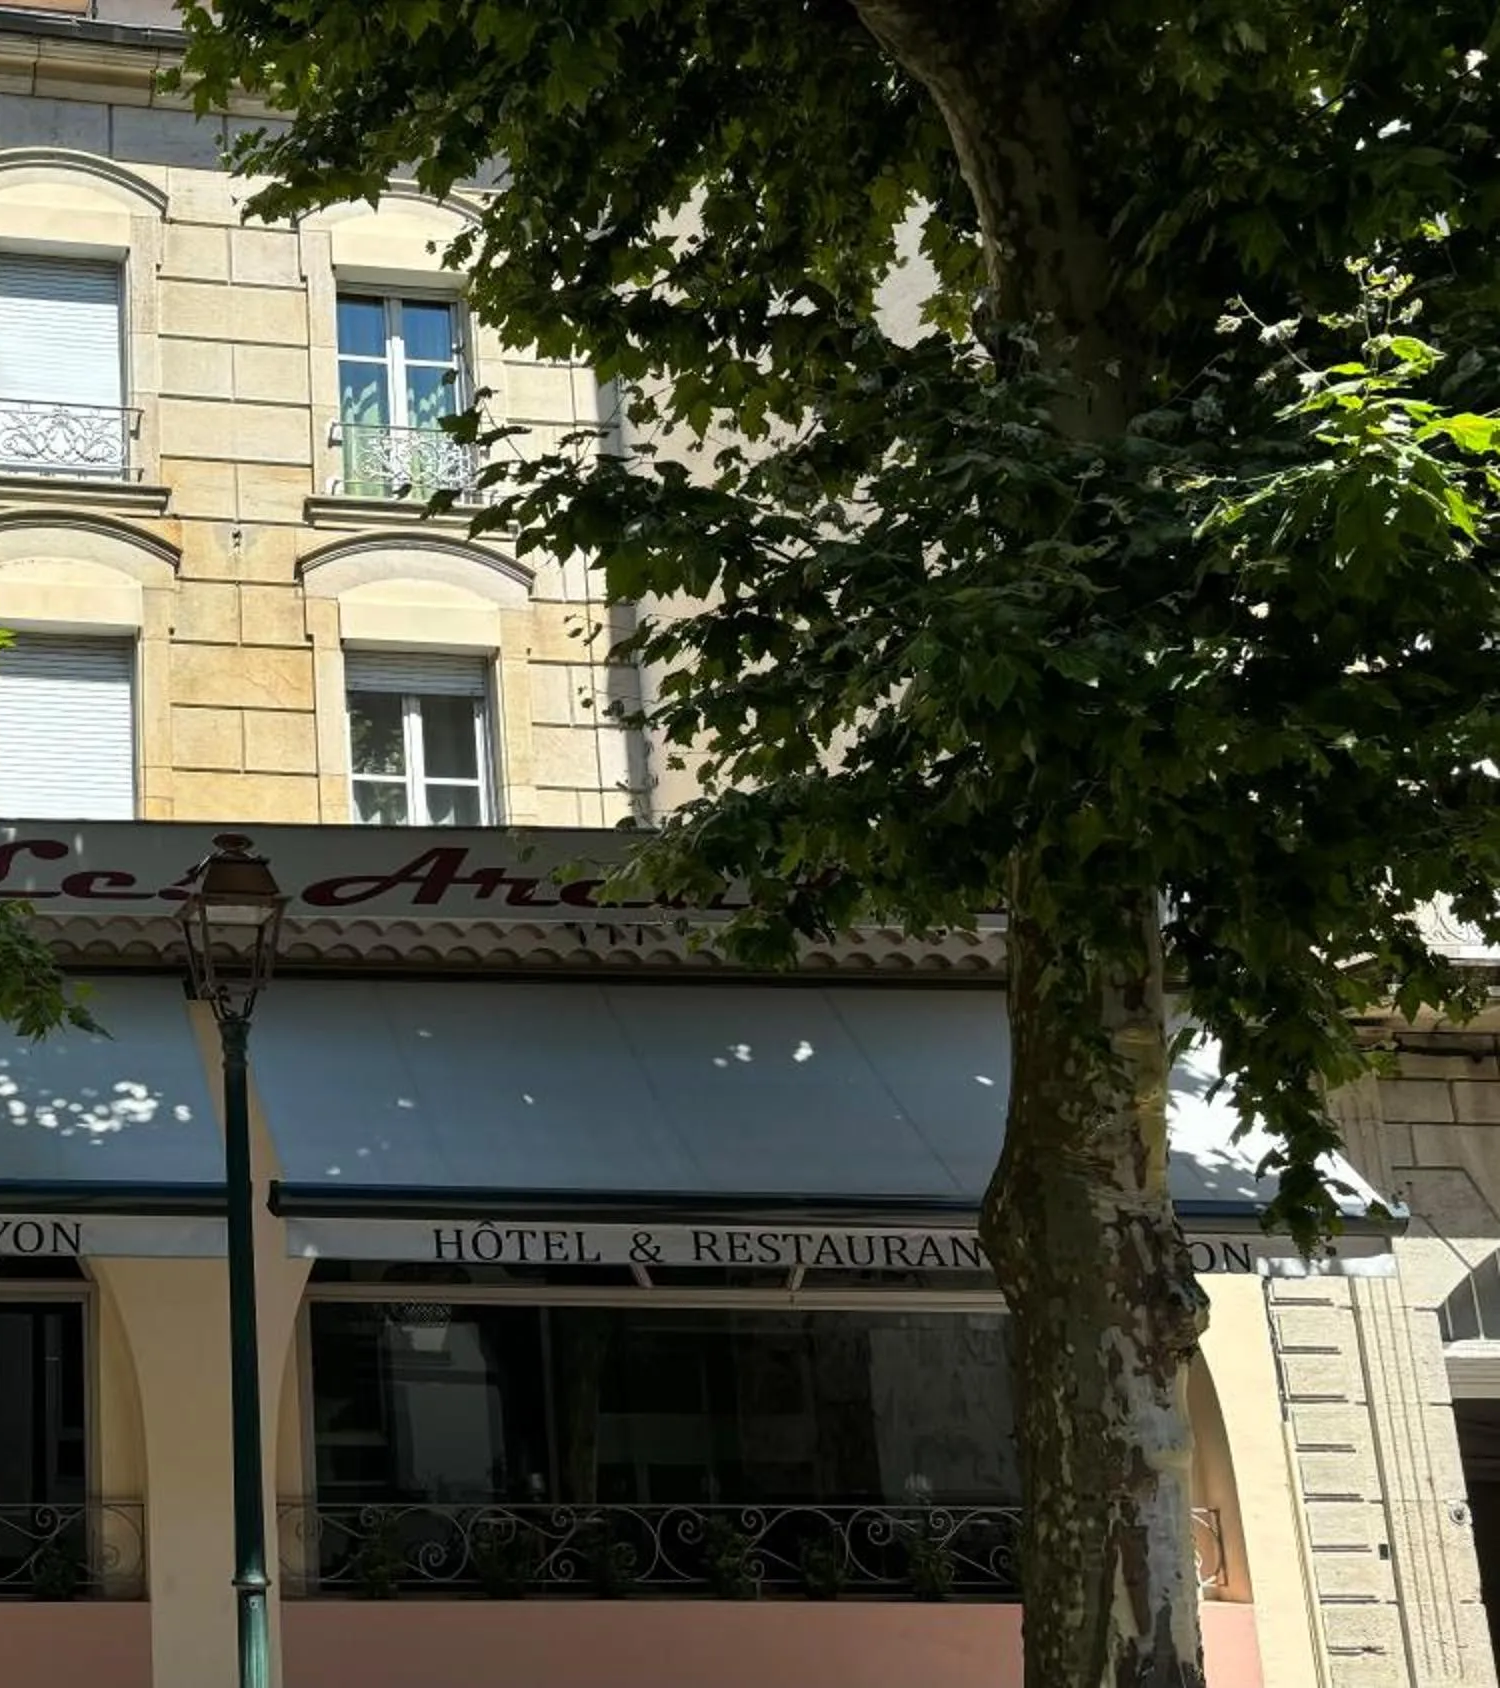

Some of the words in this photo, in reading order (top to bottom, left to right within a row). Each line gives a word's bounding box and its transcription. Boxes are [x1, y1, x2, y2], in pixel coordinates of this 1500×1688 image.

[433, 1220, 601, 1263] HÔTEL
[628, 1230, 662, 1263] &
[691, 1230, 984, 1267] RESTAURAN
